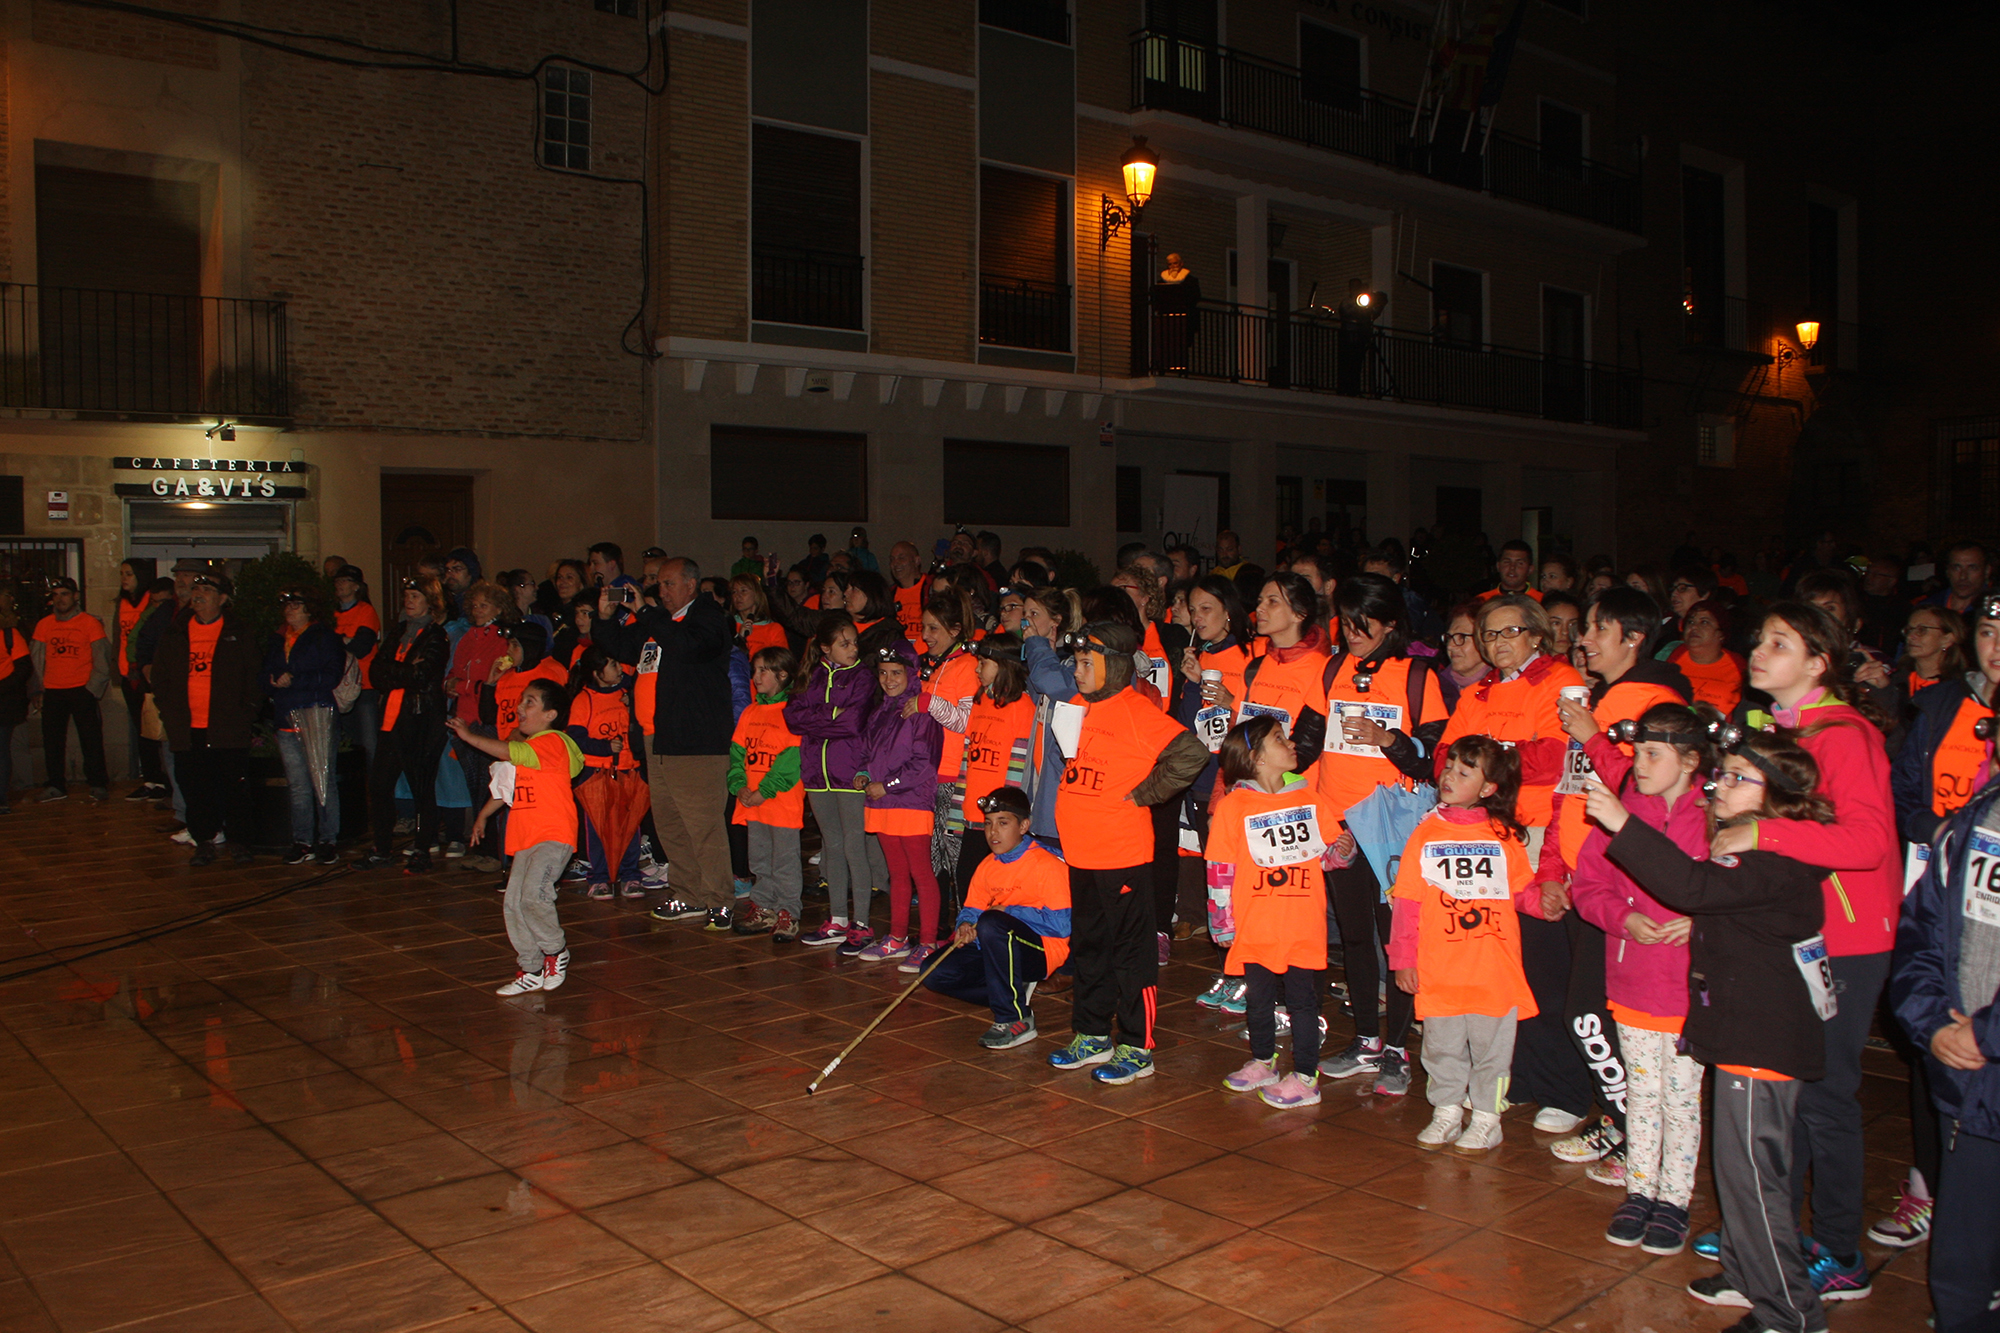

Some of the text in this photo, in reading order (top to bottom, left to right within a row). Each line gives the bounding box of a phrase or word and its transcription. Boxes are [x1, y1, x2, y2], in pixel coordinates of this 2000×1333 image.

[132, 458, 292, 472] CAFETERIA
[1204, 716, 1230, 736] 19
[1569, 751, 1595, 773] 183
[1251, 811, 1312, 829] EL QUIJOTE
[1262, 822, 1310, 847] 193
[1444, 847, 1500, 856] QUIJOTE
[1437, 857, 1494, 879] 184
[1573, 1012, 1628, 1115] didas
